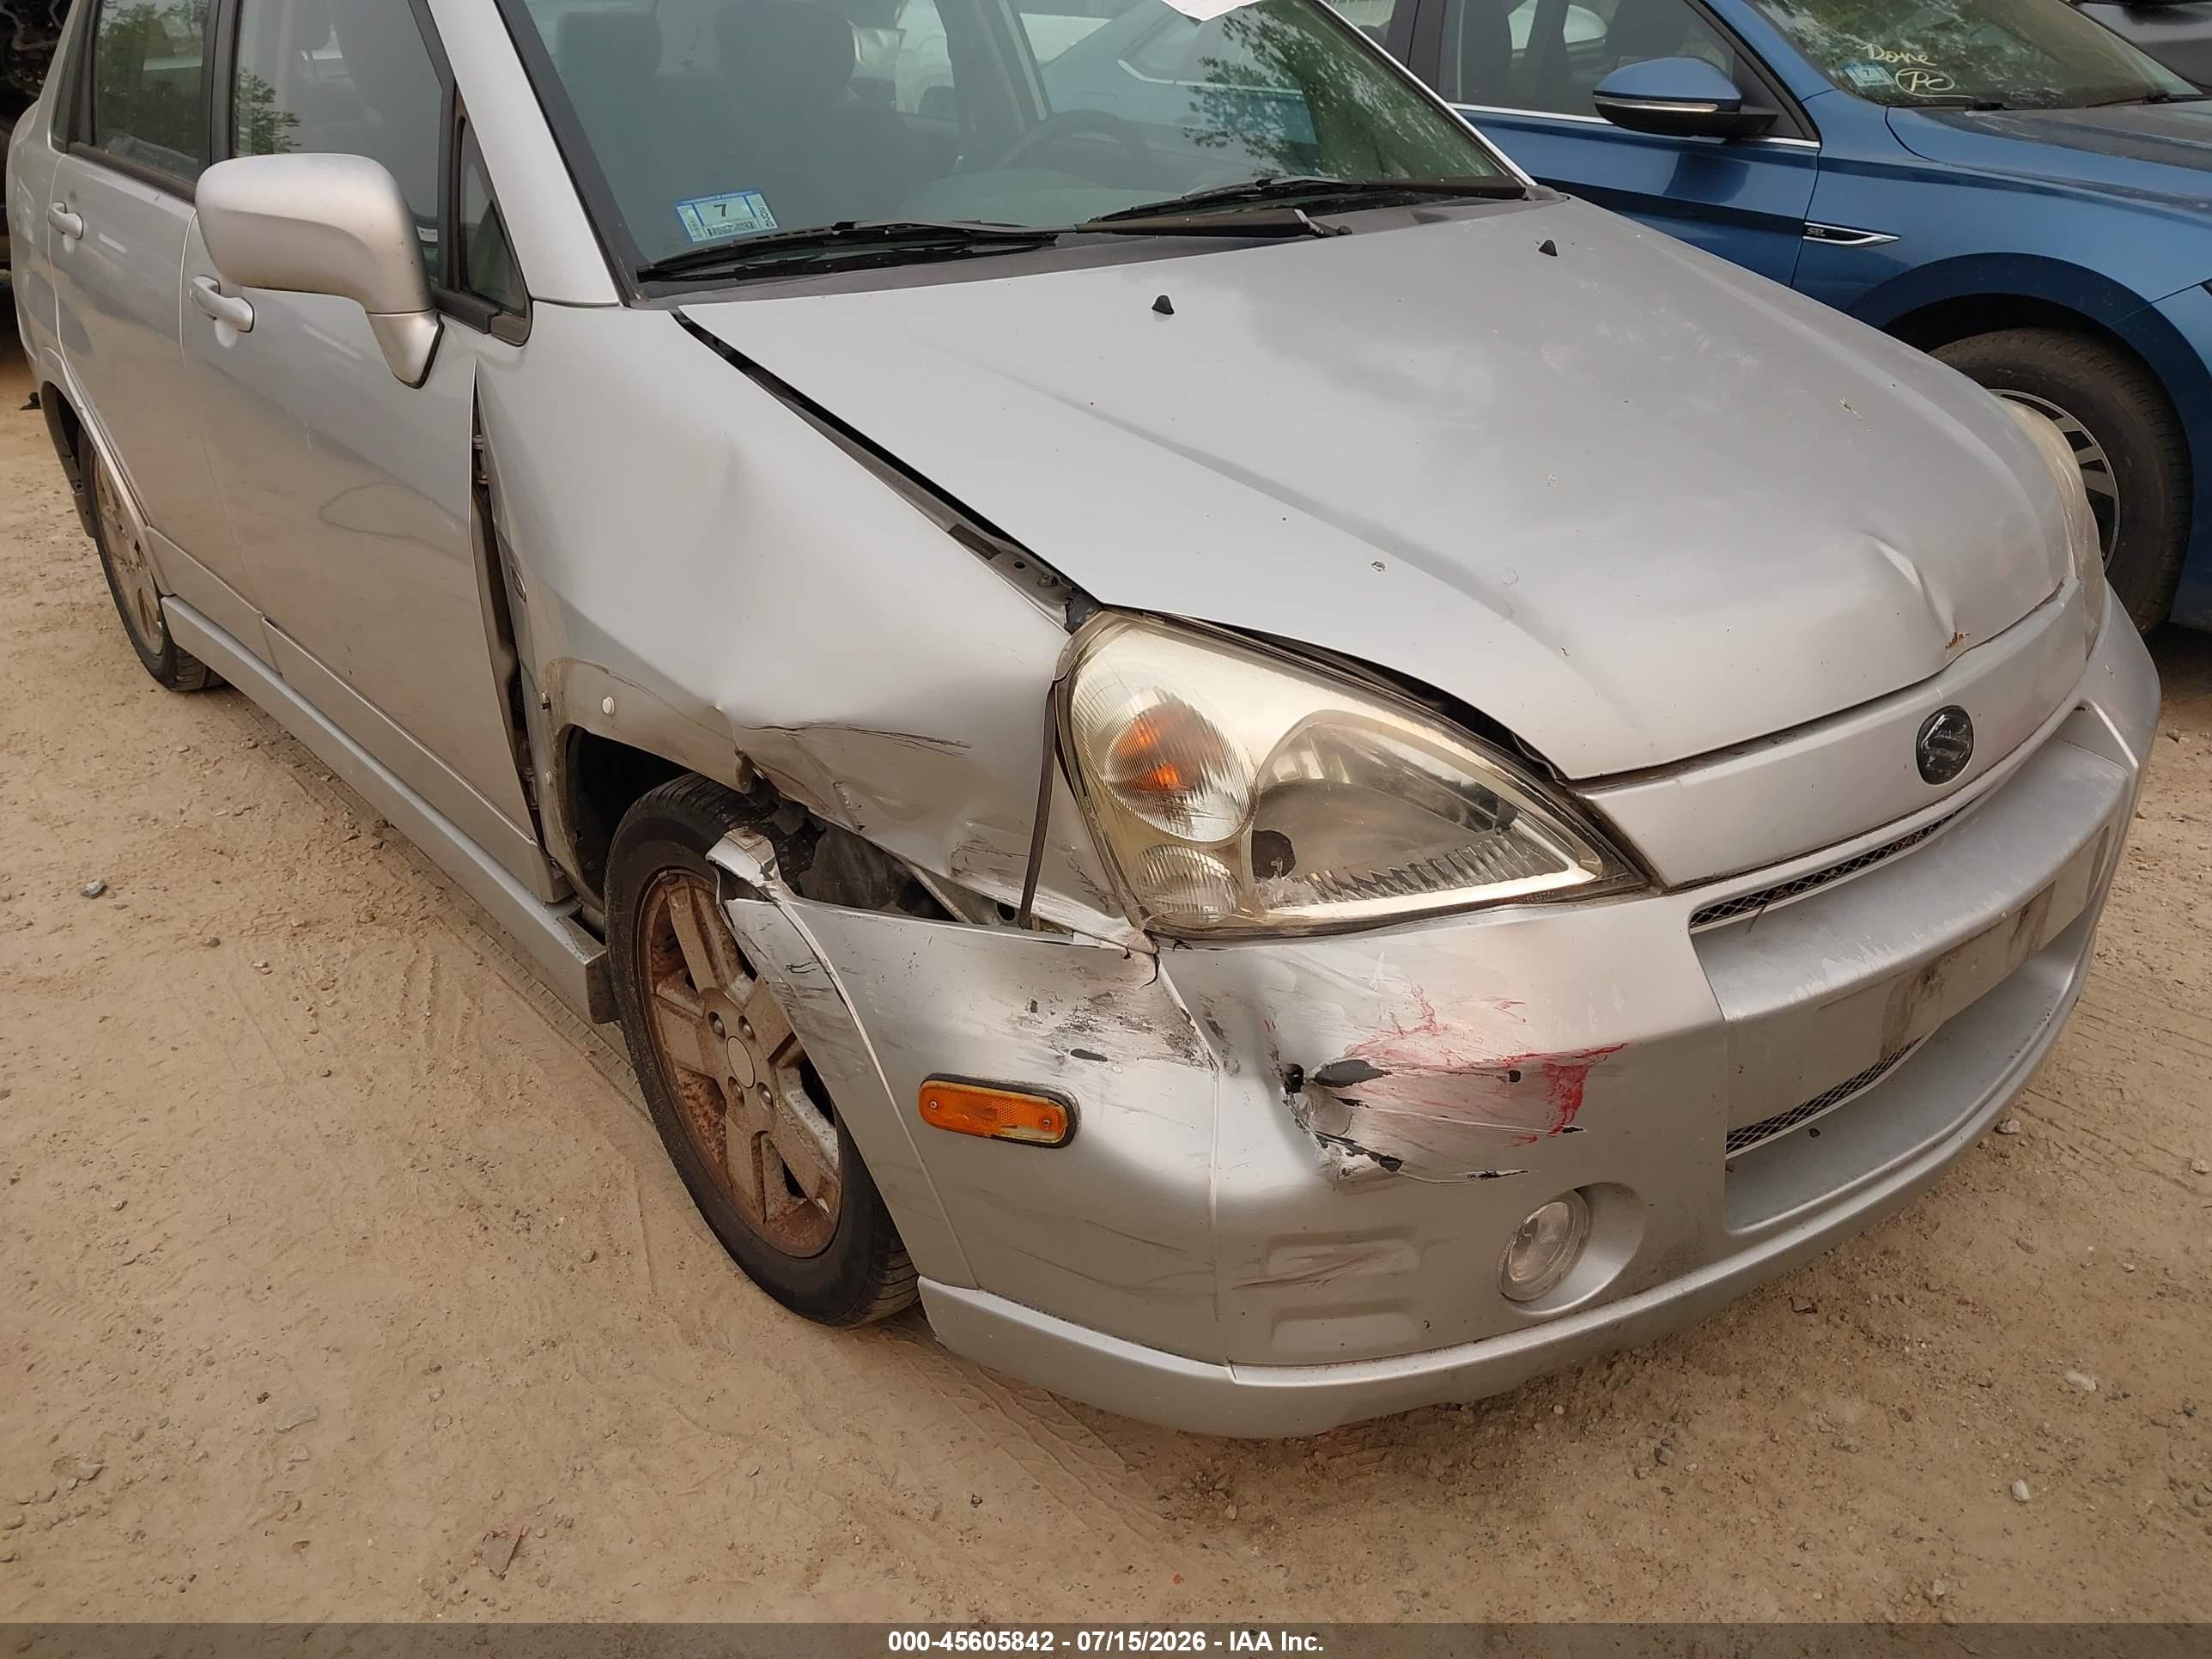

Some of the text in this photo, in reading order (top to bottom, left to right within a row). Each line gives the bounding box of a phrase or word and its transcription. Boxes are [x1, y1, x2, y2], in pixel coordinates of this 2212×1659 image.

[1856, 44, 1937, 66] Done
[714, 204, 726, 217] 7
[1806, 228, 1826, 237] SEL
